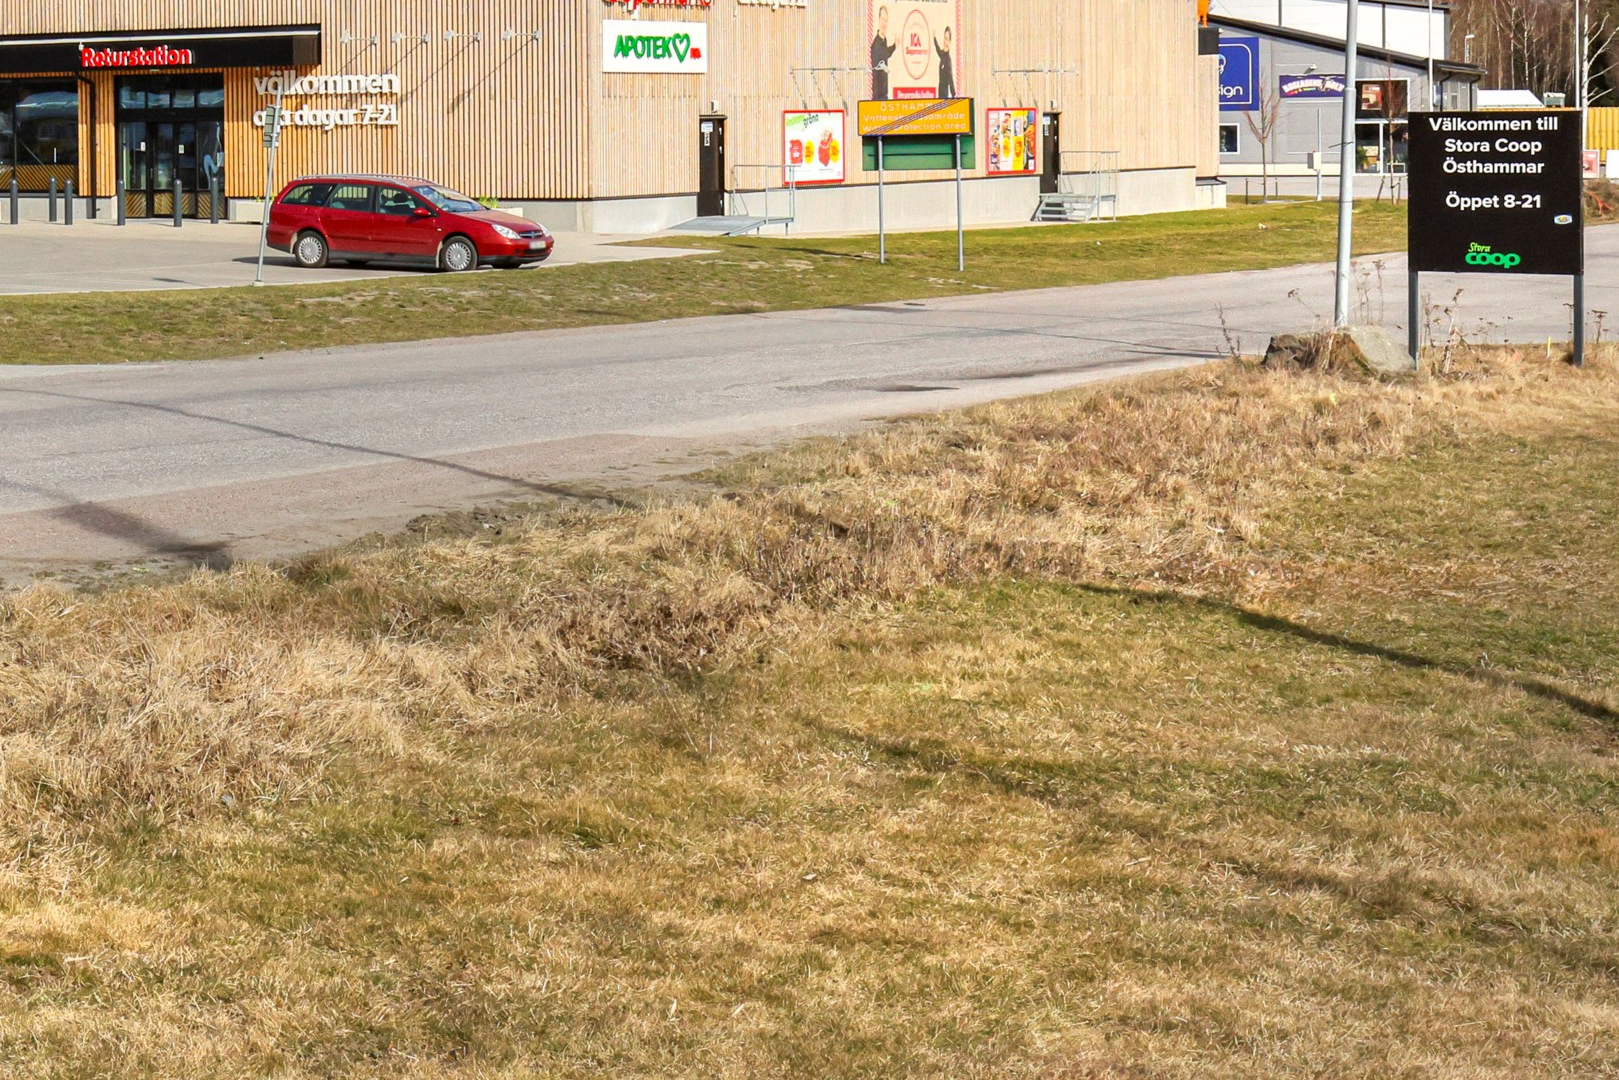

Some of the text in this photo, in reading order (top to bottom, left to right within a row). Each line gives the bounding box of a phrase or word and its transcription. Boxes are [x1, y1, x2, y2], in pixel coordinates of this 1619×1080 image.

[614, 34, 674, 59] APOTEK
[81, 45, 192, 67] Returstation
[253, 70, 399, 95] välkommen
[253, 104, 398, 131] aa dagar 7-21
[1428, 117, 1558, 131] Välkommen till
[1444, 138, 1543, 155] Stora Coop
[1443, 157, 1545, 174] Östhammar
[1445, 191, 1541, 211] Öppet 8-21
[1468, 242, 1491, 252] Stora
[1465, 253, 1521, 269] coop
